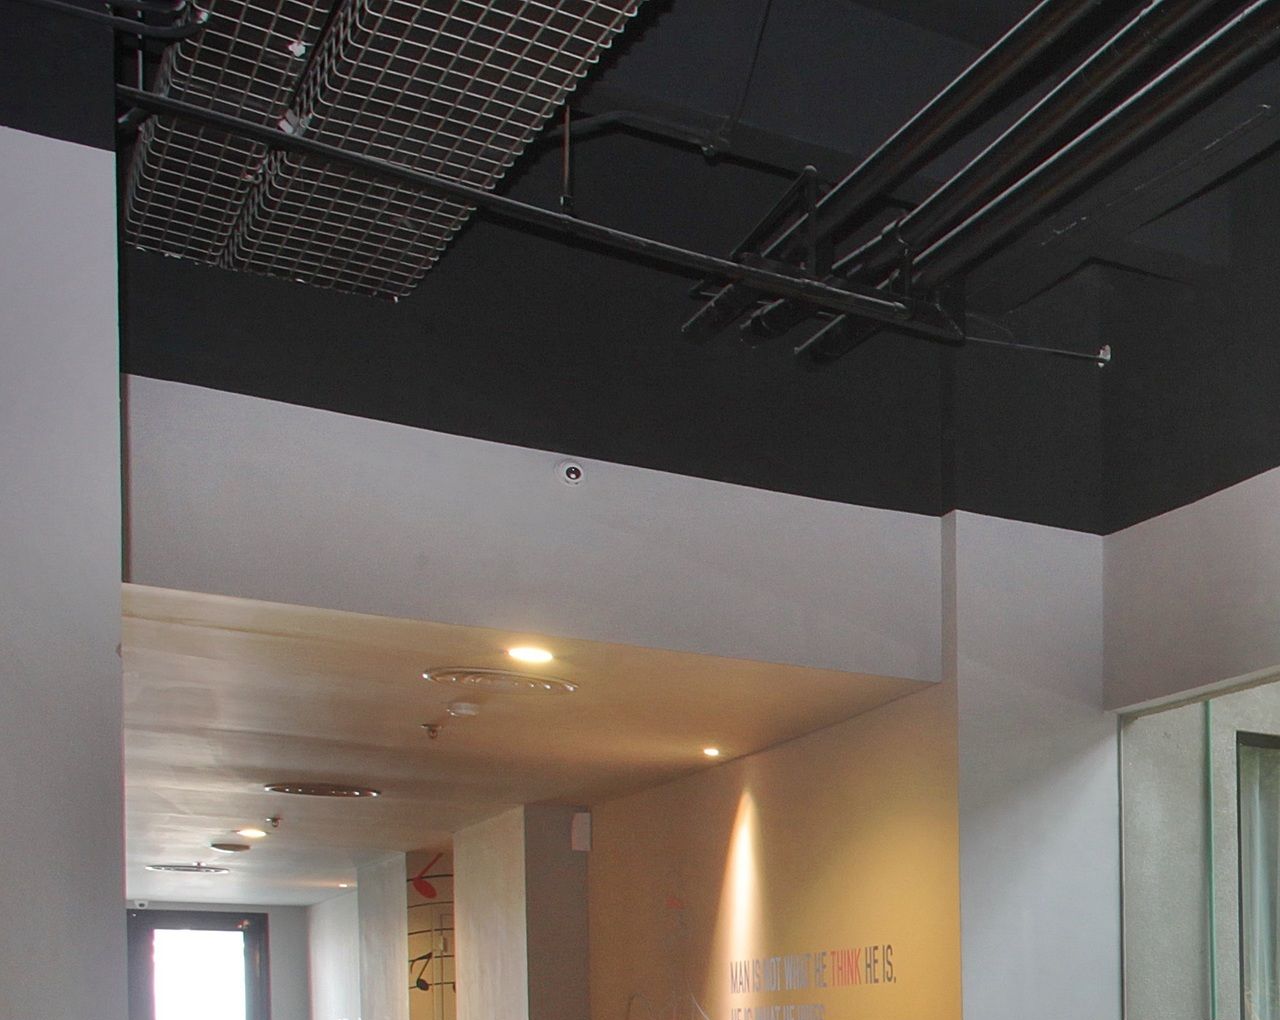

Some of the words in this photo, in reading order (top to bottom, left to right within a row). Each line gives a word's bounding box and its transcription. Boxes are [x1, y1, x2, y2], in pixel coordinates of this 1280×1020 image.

[730, 961, 750, 993] MAN
[752, 959, 760, 992] IS
[815, 951, 828, 988] HE
[830, 948, 861, 987] THINK
[865, 946, 879, 984] HE
[883, 944, 897, 983] IS.
